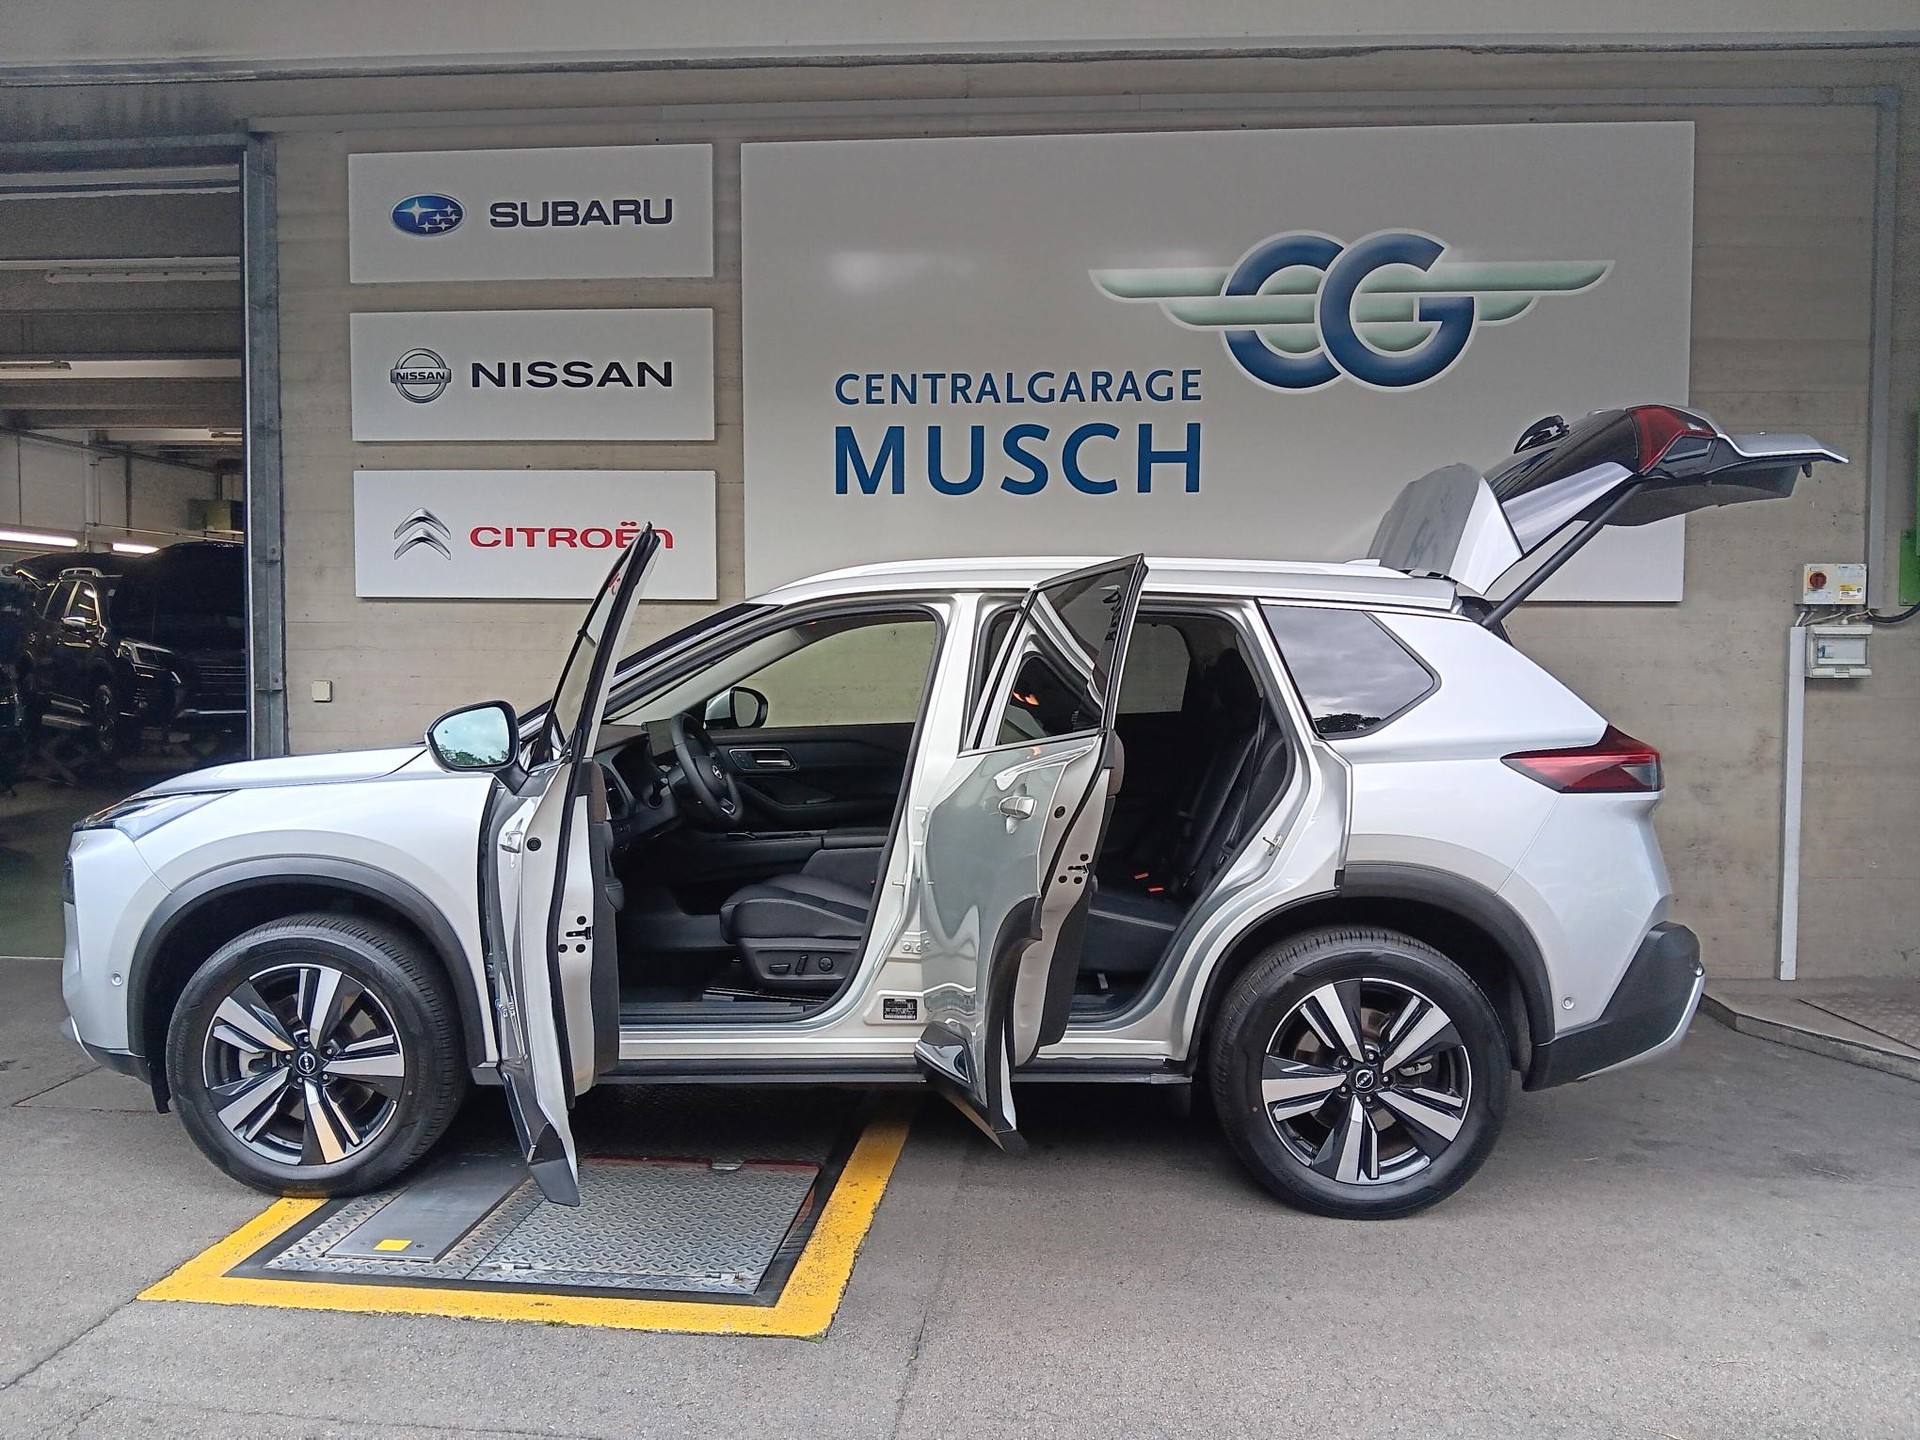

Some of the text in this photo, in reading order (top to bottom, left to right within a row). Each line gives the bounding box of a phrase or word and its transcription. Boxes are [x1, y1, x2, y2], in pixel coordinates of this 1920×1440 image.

[489, 198, 673, 228] SUBARU
[396, 372, 446, 380] NISSAN
[471, 360, 673, 389] NISSAN
[835, 369, 1202, 406] CENTRALGARAGE
[835, 422, 1201, 496] MUSCH
